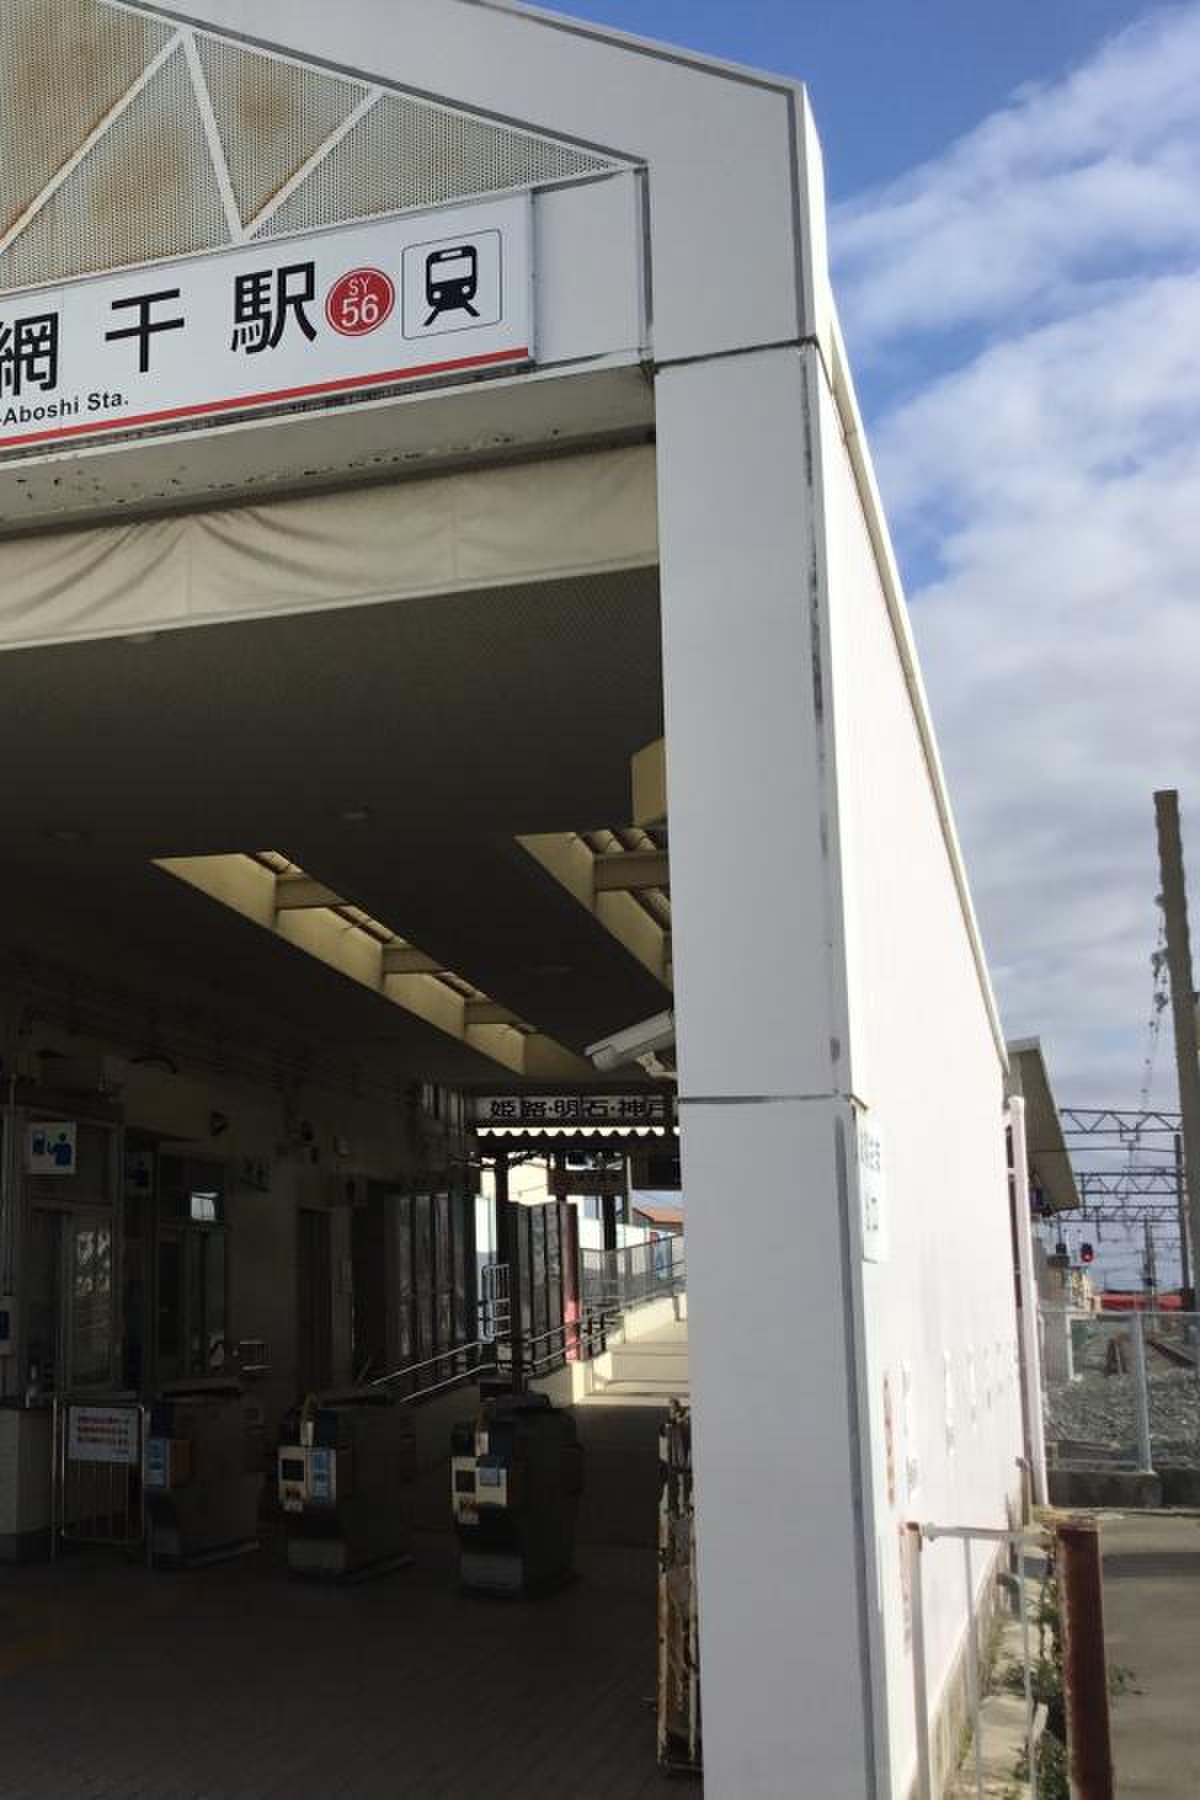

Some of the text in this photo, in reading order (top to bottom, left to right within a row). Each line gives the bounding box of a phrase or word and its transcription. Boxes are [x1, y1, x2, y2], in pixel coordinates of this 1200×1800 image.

[348, 277, 370, 295] SY
[342, 294, 379, 327] 56
[87, 390, 129, 411] Sta.
